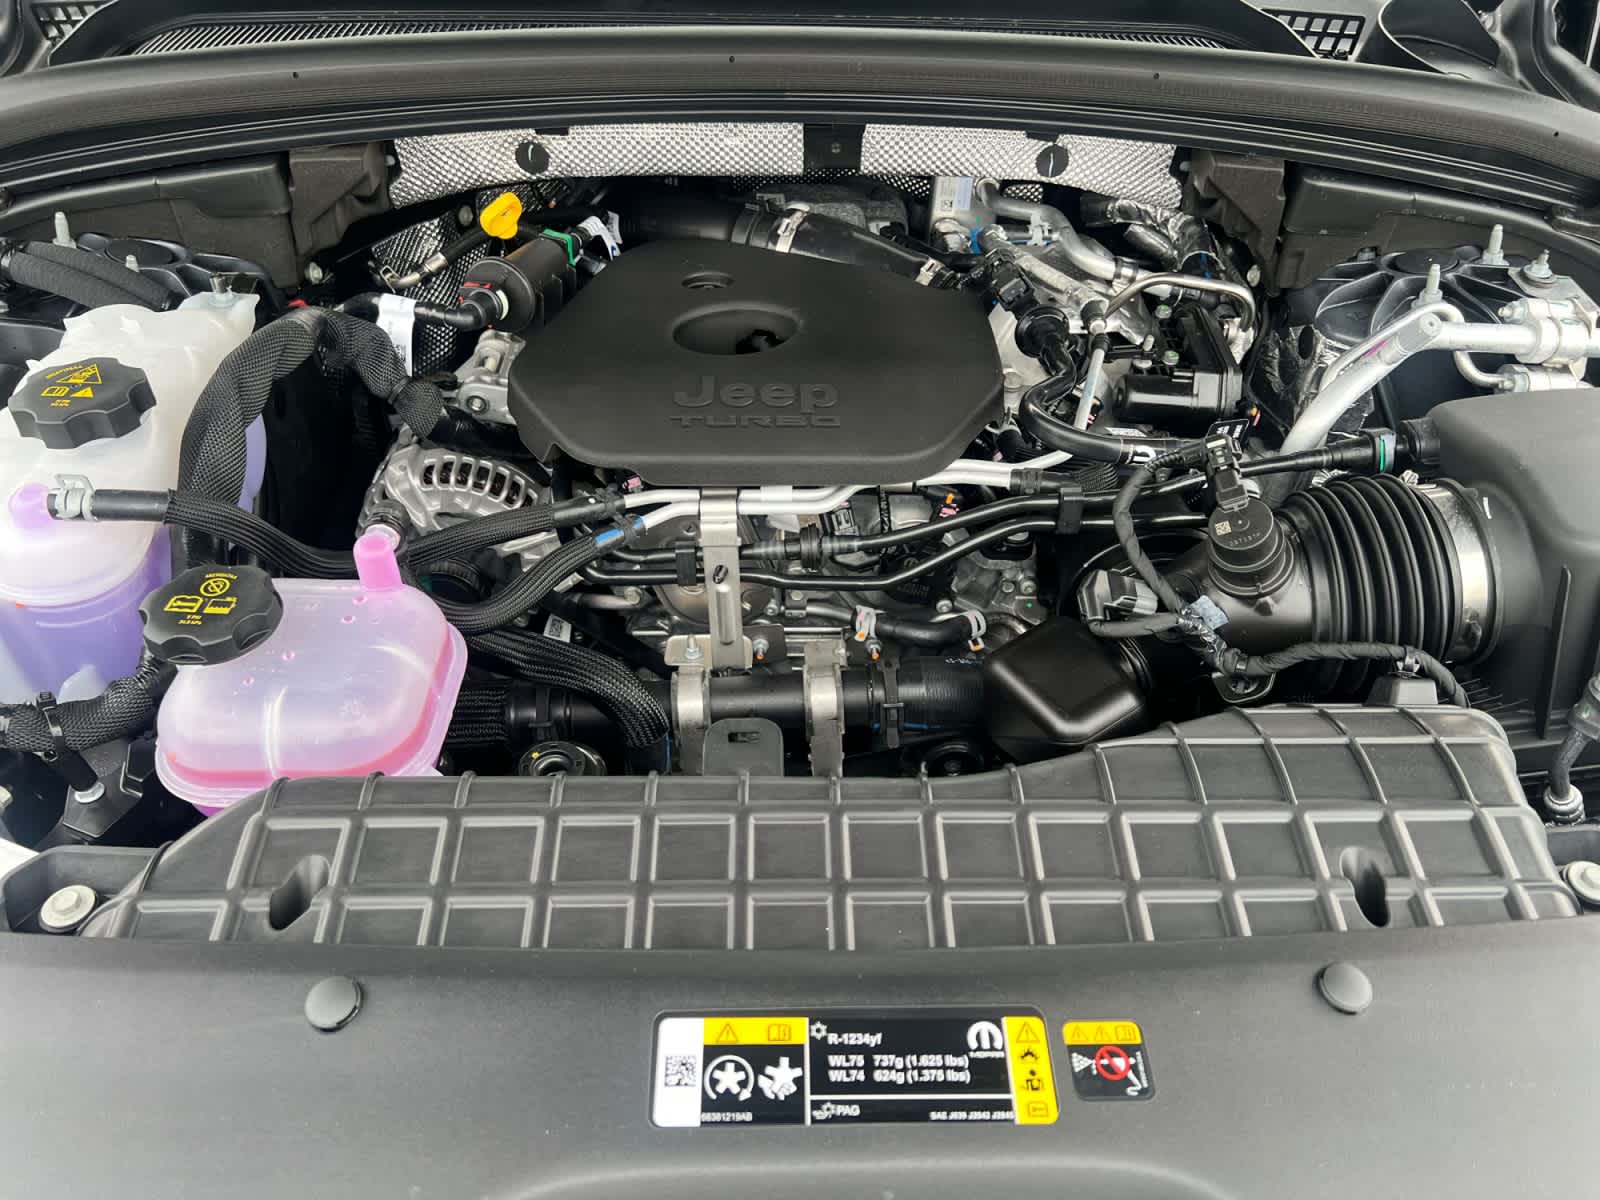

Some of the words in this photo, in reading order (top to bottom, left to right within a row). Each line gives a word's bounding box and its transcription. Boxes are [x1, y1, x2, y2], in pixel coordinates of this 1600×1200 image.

[672, 375, 839, 415] Jeep
[669, 415, 841, 430] TURBO
[827, 1032, 882, 1047] R-1234yf
[827, 1054, 865, 1068] WL75
[872, 1054, 904, 1069] 737g
[905, 1054, 943, 1069] (1.625
[944, 1054, 969, 1069] lbs)
[828, 1069, 865, 1082] WL74
[873, 1069, 905, 1084] 624g
[906, 1069, 944, 1084] (1.375
[945, 1069, 971, 1084] lbs)
[836, 1104, 861, 1116] PAG
